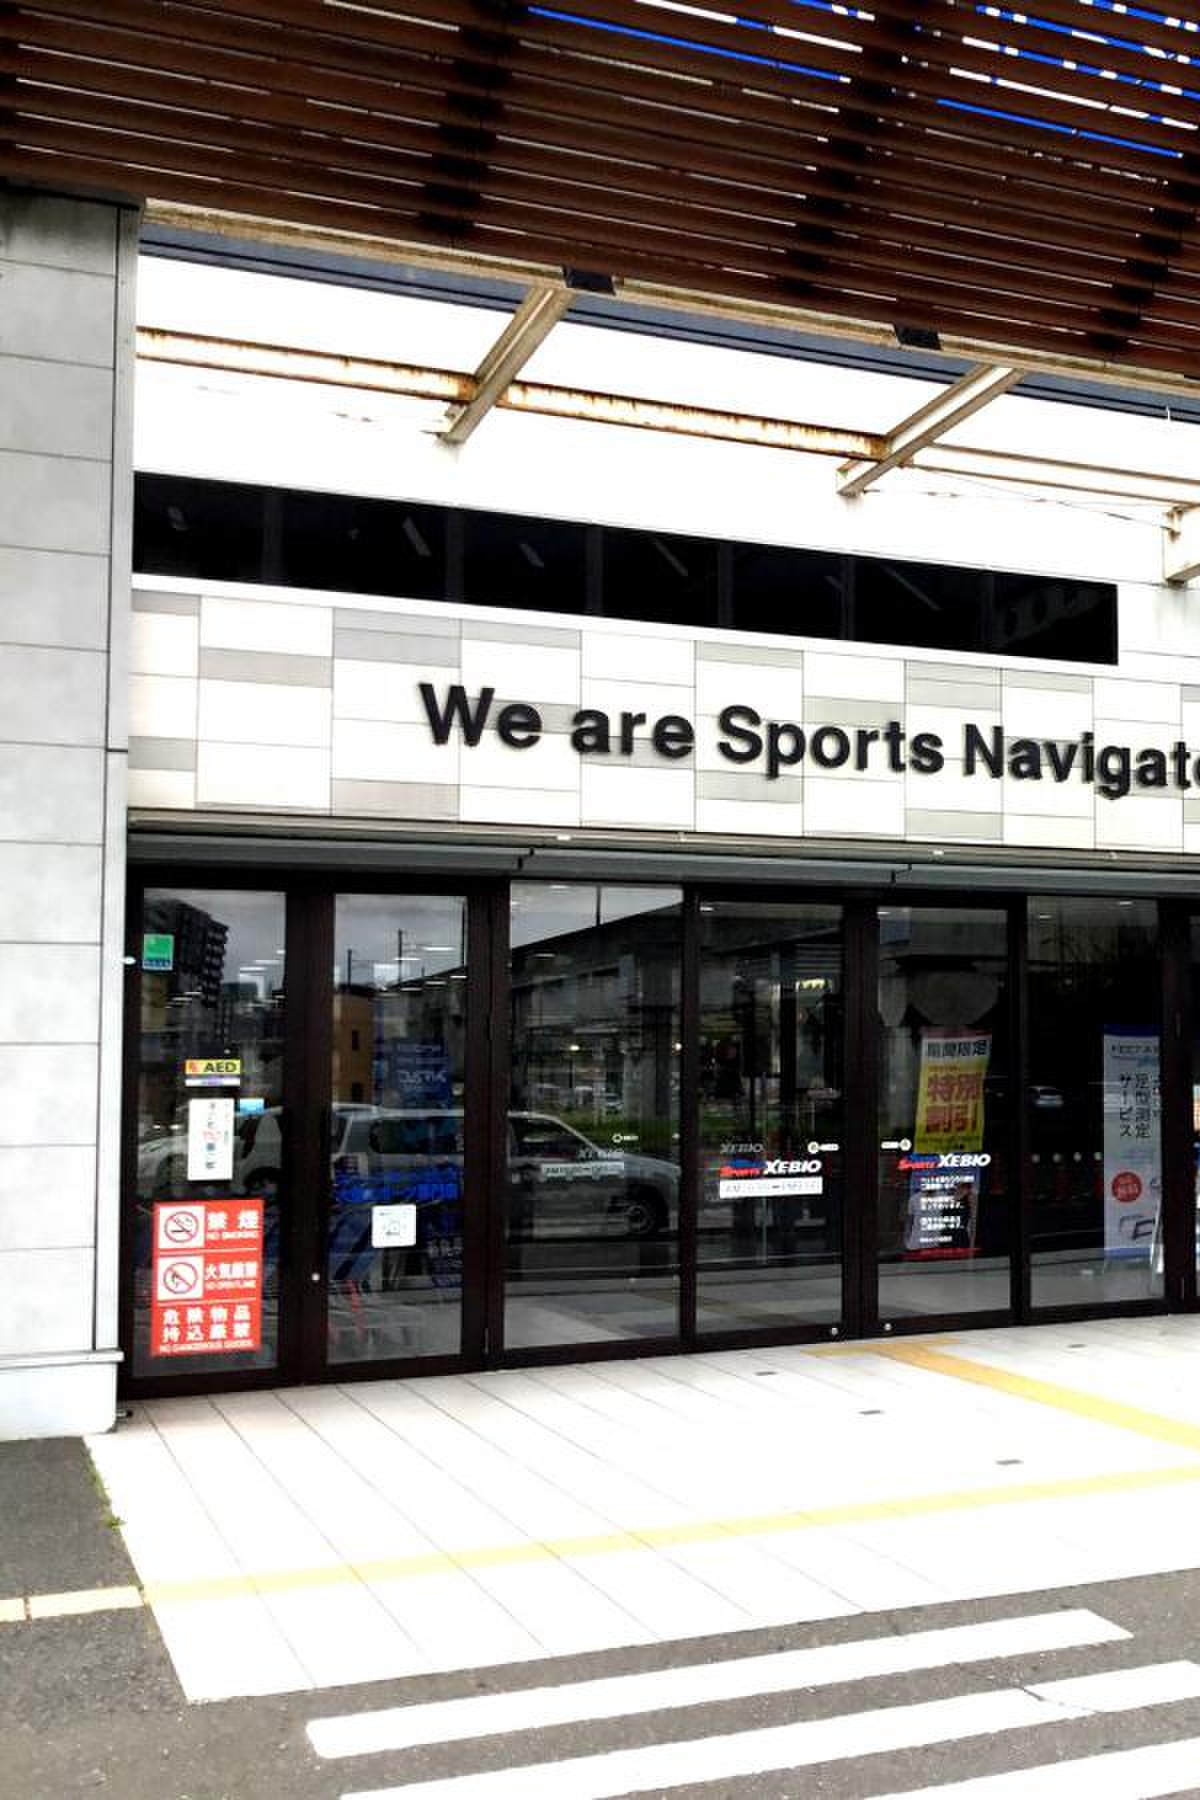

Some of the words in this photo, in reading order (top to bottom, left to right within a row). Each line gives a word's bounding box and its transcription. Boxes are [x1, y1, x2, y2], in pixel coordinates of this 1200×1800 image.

[418, 683, 543, 749] We
[571, 708, 695, 759] are
[718, 705, 945, 779] Sports
[203, 1062, 238, 1073] AED
[1118, 1072, 1133, 1138] サービス
[763, 1159, 822, 1175] XEBIO
[938, 1153, 991, 1168] XEBIO
